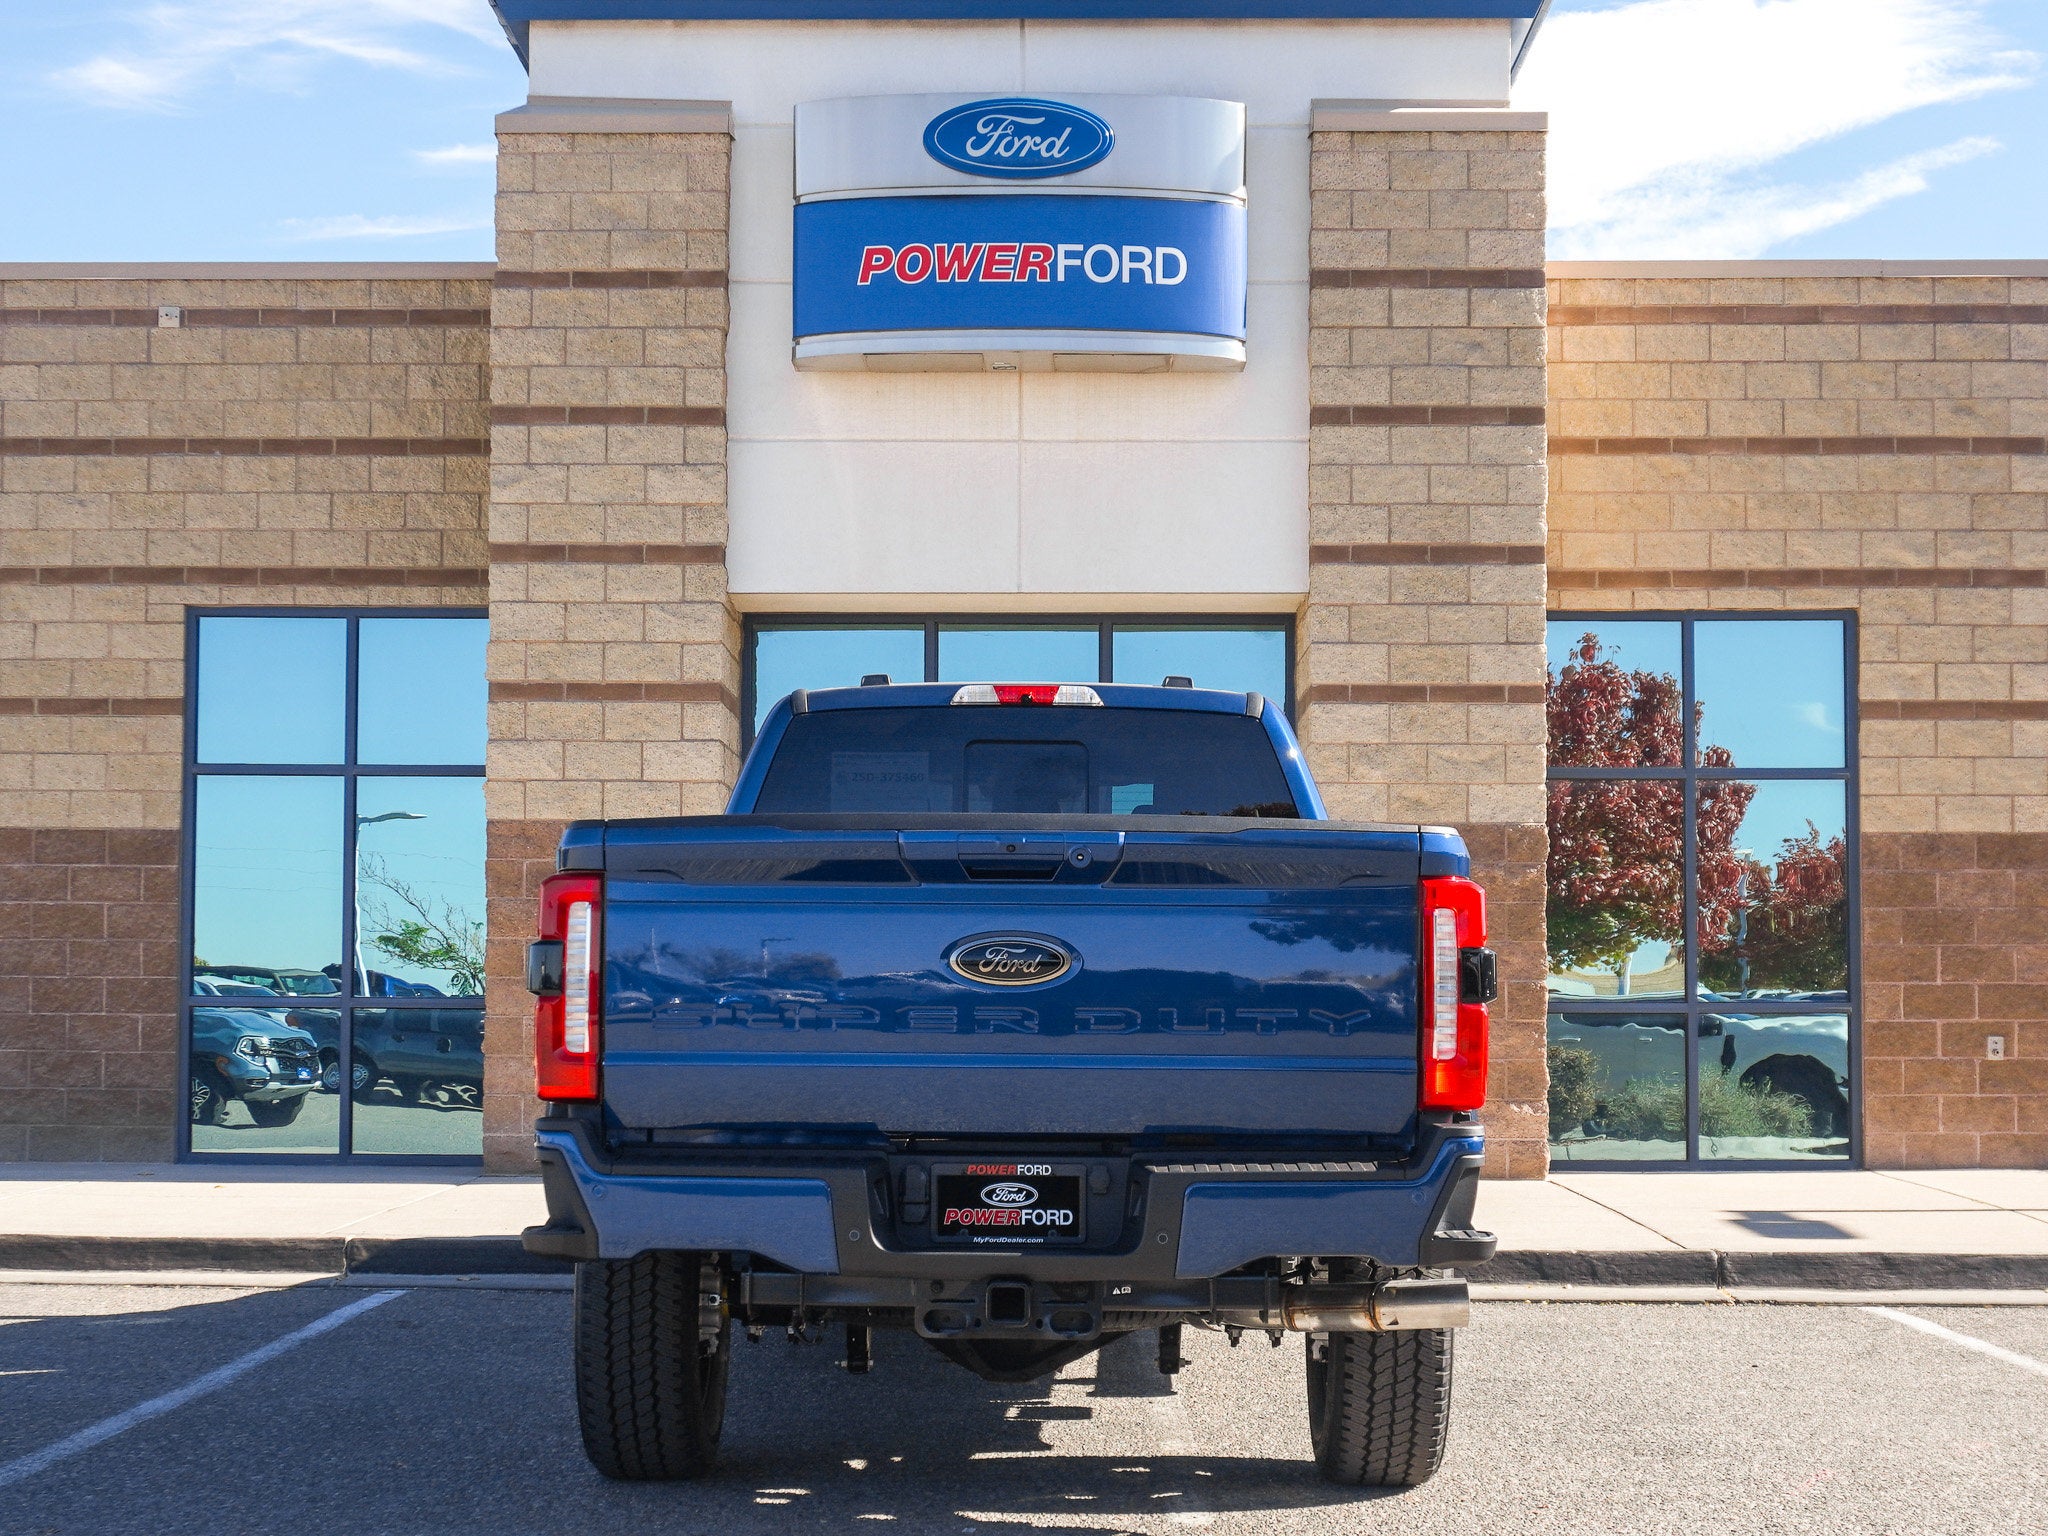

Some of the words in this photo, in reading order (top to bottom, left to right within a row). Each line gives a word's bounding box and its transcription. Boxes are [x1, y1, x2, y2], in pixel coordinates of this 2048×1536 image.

[966, 114, 1072, 159] Ford
[857, 242, 1188, 286] POWERFORD
[978, 946, 1043, 973] Ford
[652, 1003, 1039, 1034] SUPER
[1074, 1007, 1371, 1036] DUTY
[966, 1164, 1052, 1176] POWERFORD
[992, 1187, 1027, 1202] Ford
[944, 1208, 1074, 1226] POWERFORD
[972, 1236, 1044, 1244] MyFordDealer.com
